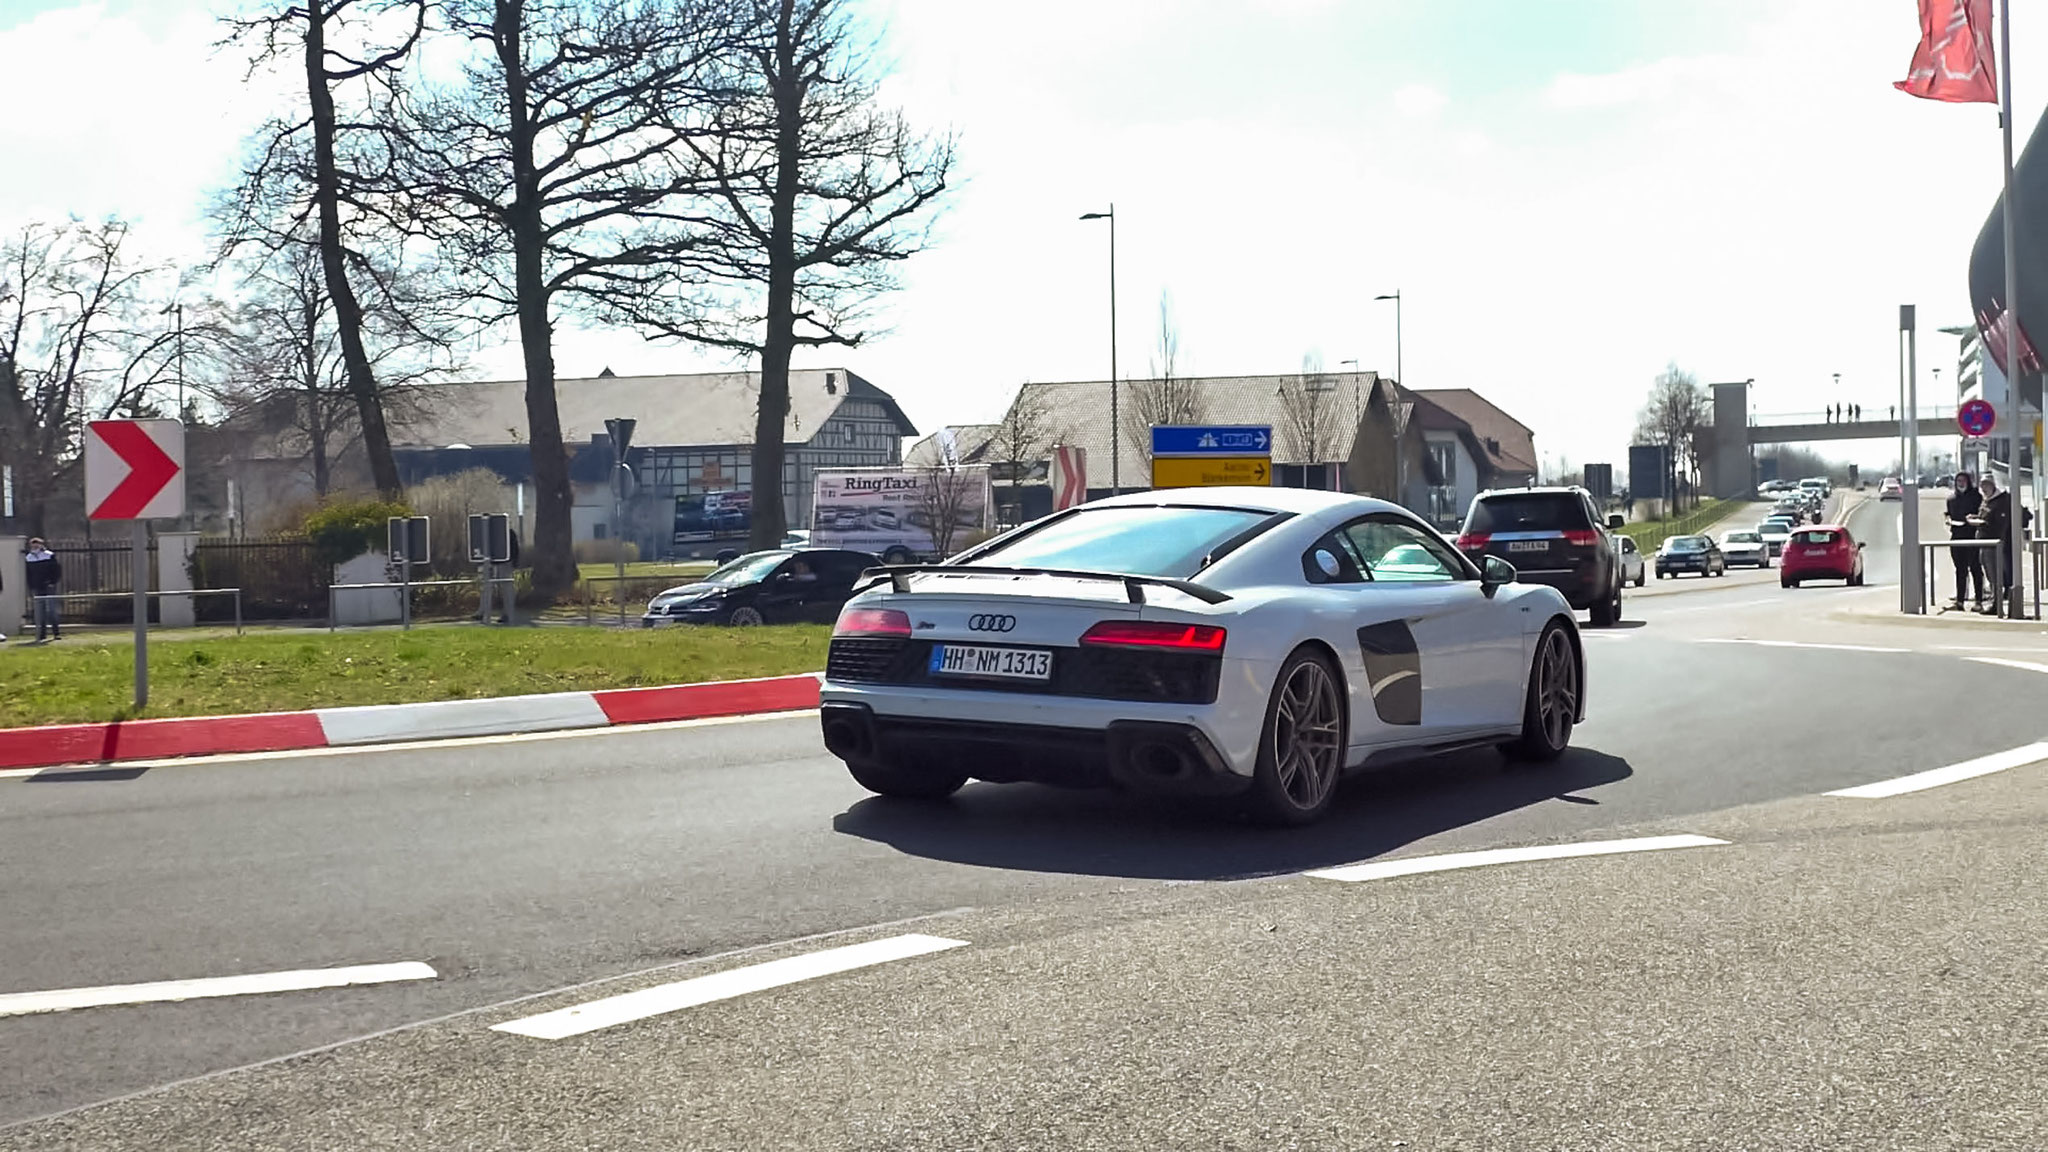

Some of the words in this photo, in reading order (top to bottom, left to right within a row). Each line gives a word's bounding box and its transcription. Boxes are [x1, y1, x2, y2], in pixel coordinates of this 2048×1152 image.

[845, 476, 917, 492] RingTaxi
[941, 648, 965, 670] HH
[976, 650, 1001, 673] NM
[1002, 652, 1050, 675] 1313
